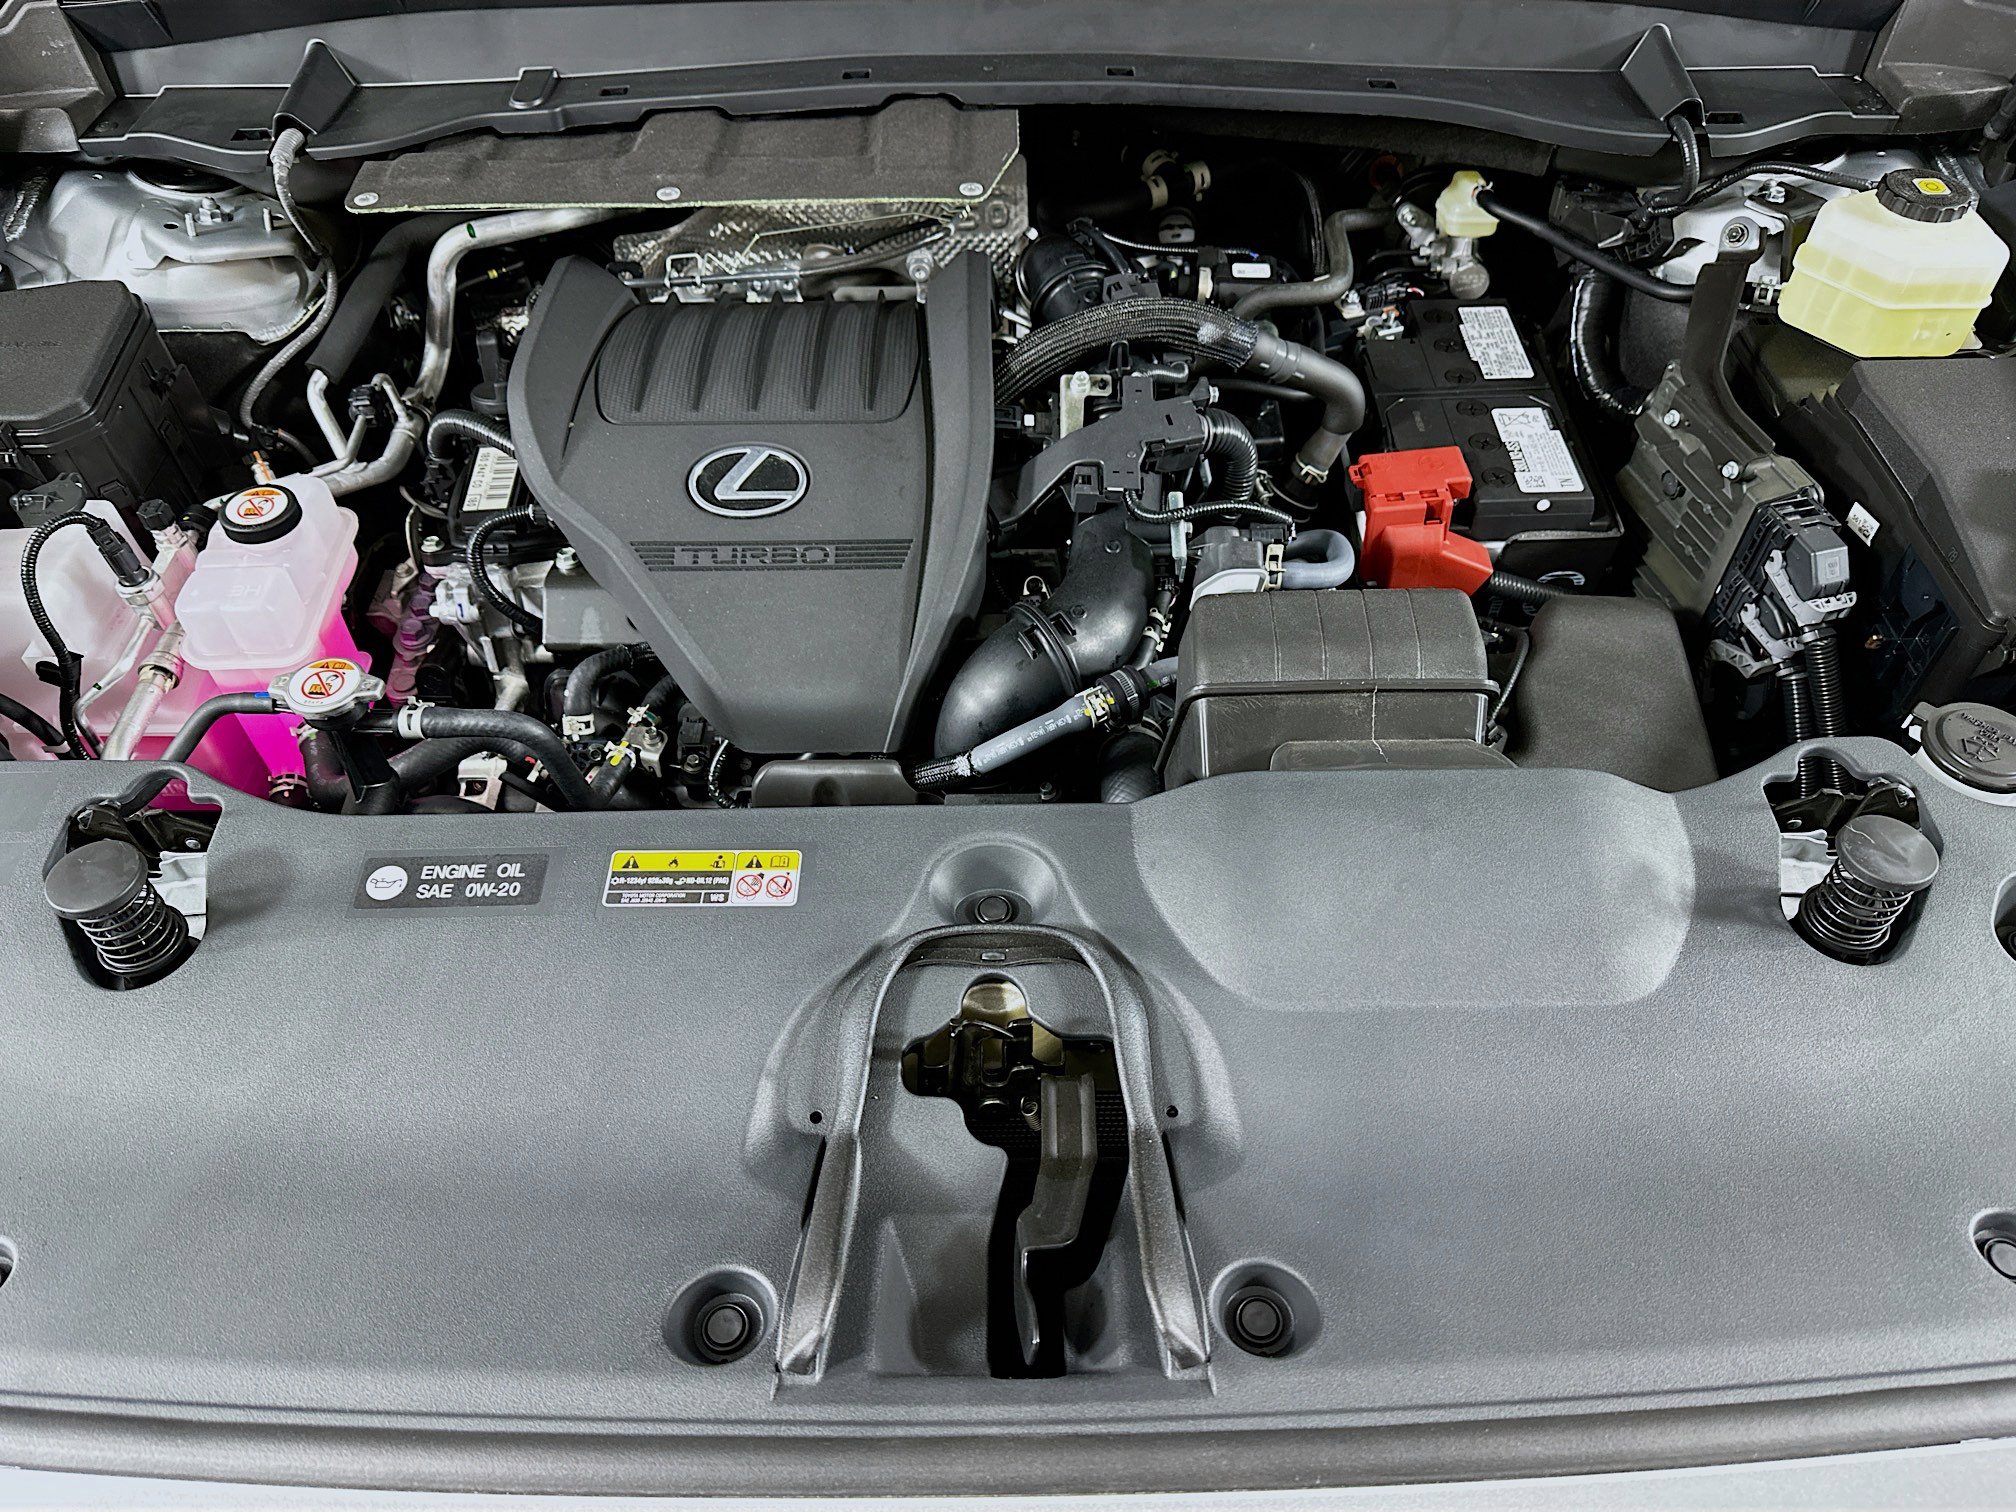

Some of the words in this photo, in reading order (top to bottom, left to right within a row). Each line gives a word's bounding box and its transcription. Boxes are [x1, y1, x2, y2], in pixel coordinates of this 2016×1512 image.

[680, 545, 832, 566] TURBO
[420, 863, 487, 880] ENGINE
[496, 862, 526, 878] OIL
[415, 884, 455, 899] SAE
[465, 881, 521, 898] 0W-20
[710, 893, 725, 902] WS
